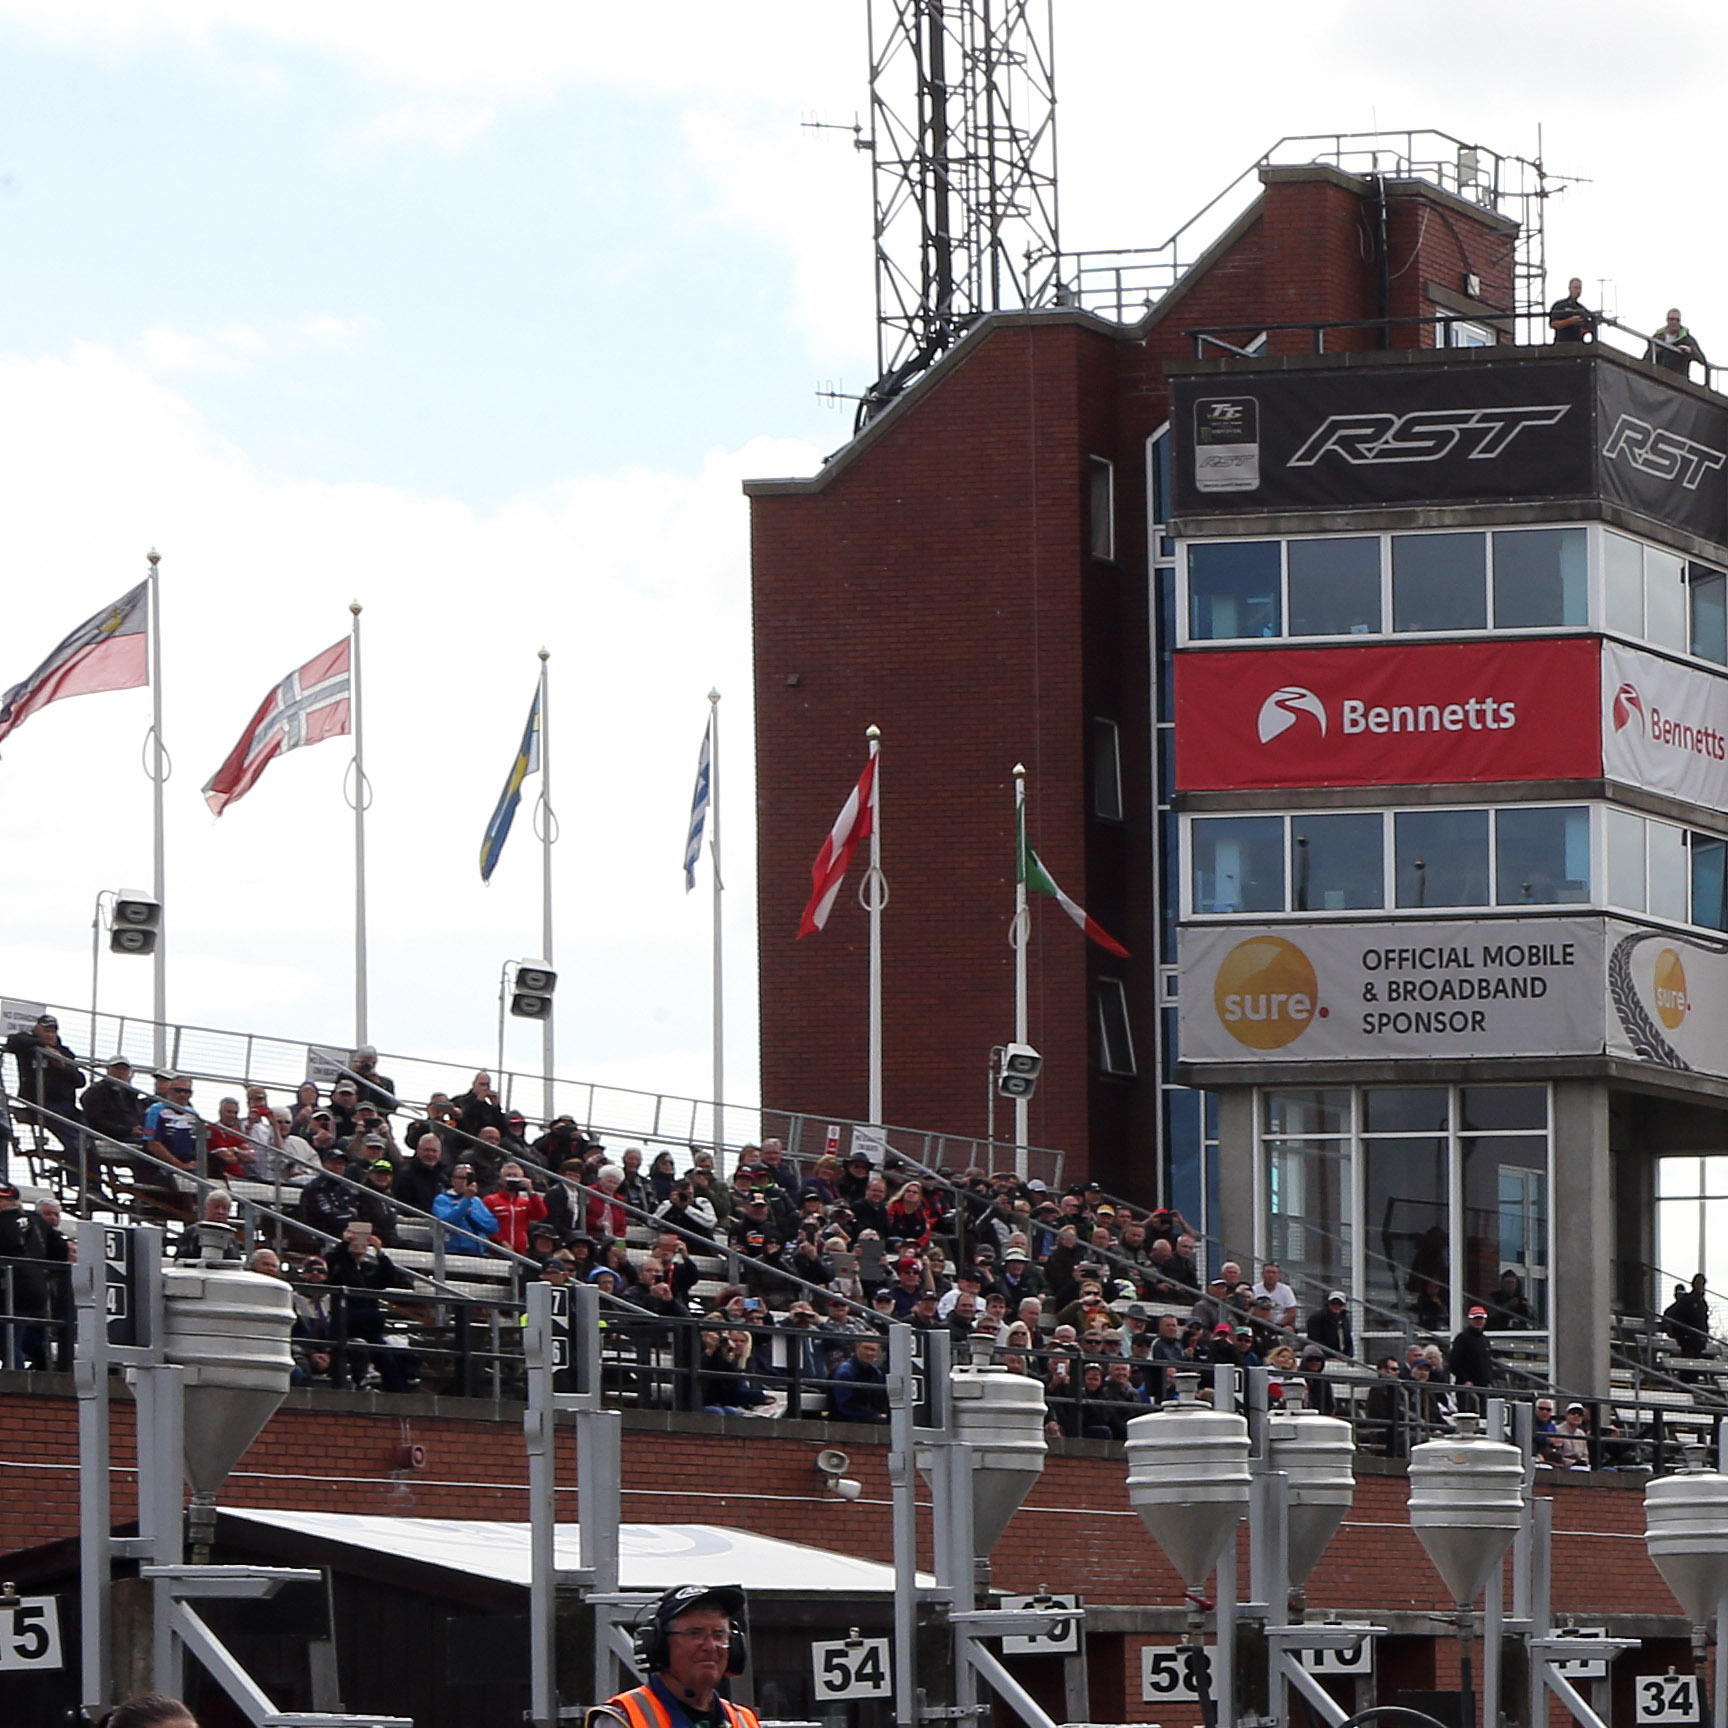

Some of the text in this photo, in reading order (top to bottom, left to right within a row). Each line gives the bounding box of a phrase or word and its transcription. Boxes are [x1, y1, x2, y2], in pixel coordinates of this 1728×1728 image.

[1286, 404, 1572, 467] RST
[1602, 413, 1727, 490] RST
[1342, 696, 1516, 735] Bennetts
[1650, 706, 1726, 761] Bennetts
[1361, 943, 1575, 971] OFFICIAL MOBILE
[1361, 976, 1548, 1003] & BROADBAND
[1361, 1010, 1487, 1035] SPONSOR
[0, 1606, 50, 1660] 5
[823, 1646, 885, 1692] 54
[1149, 1653, 1213, 1693] 58
[1641, 1681, 1693, 1717] 34
